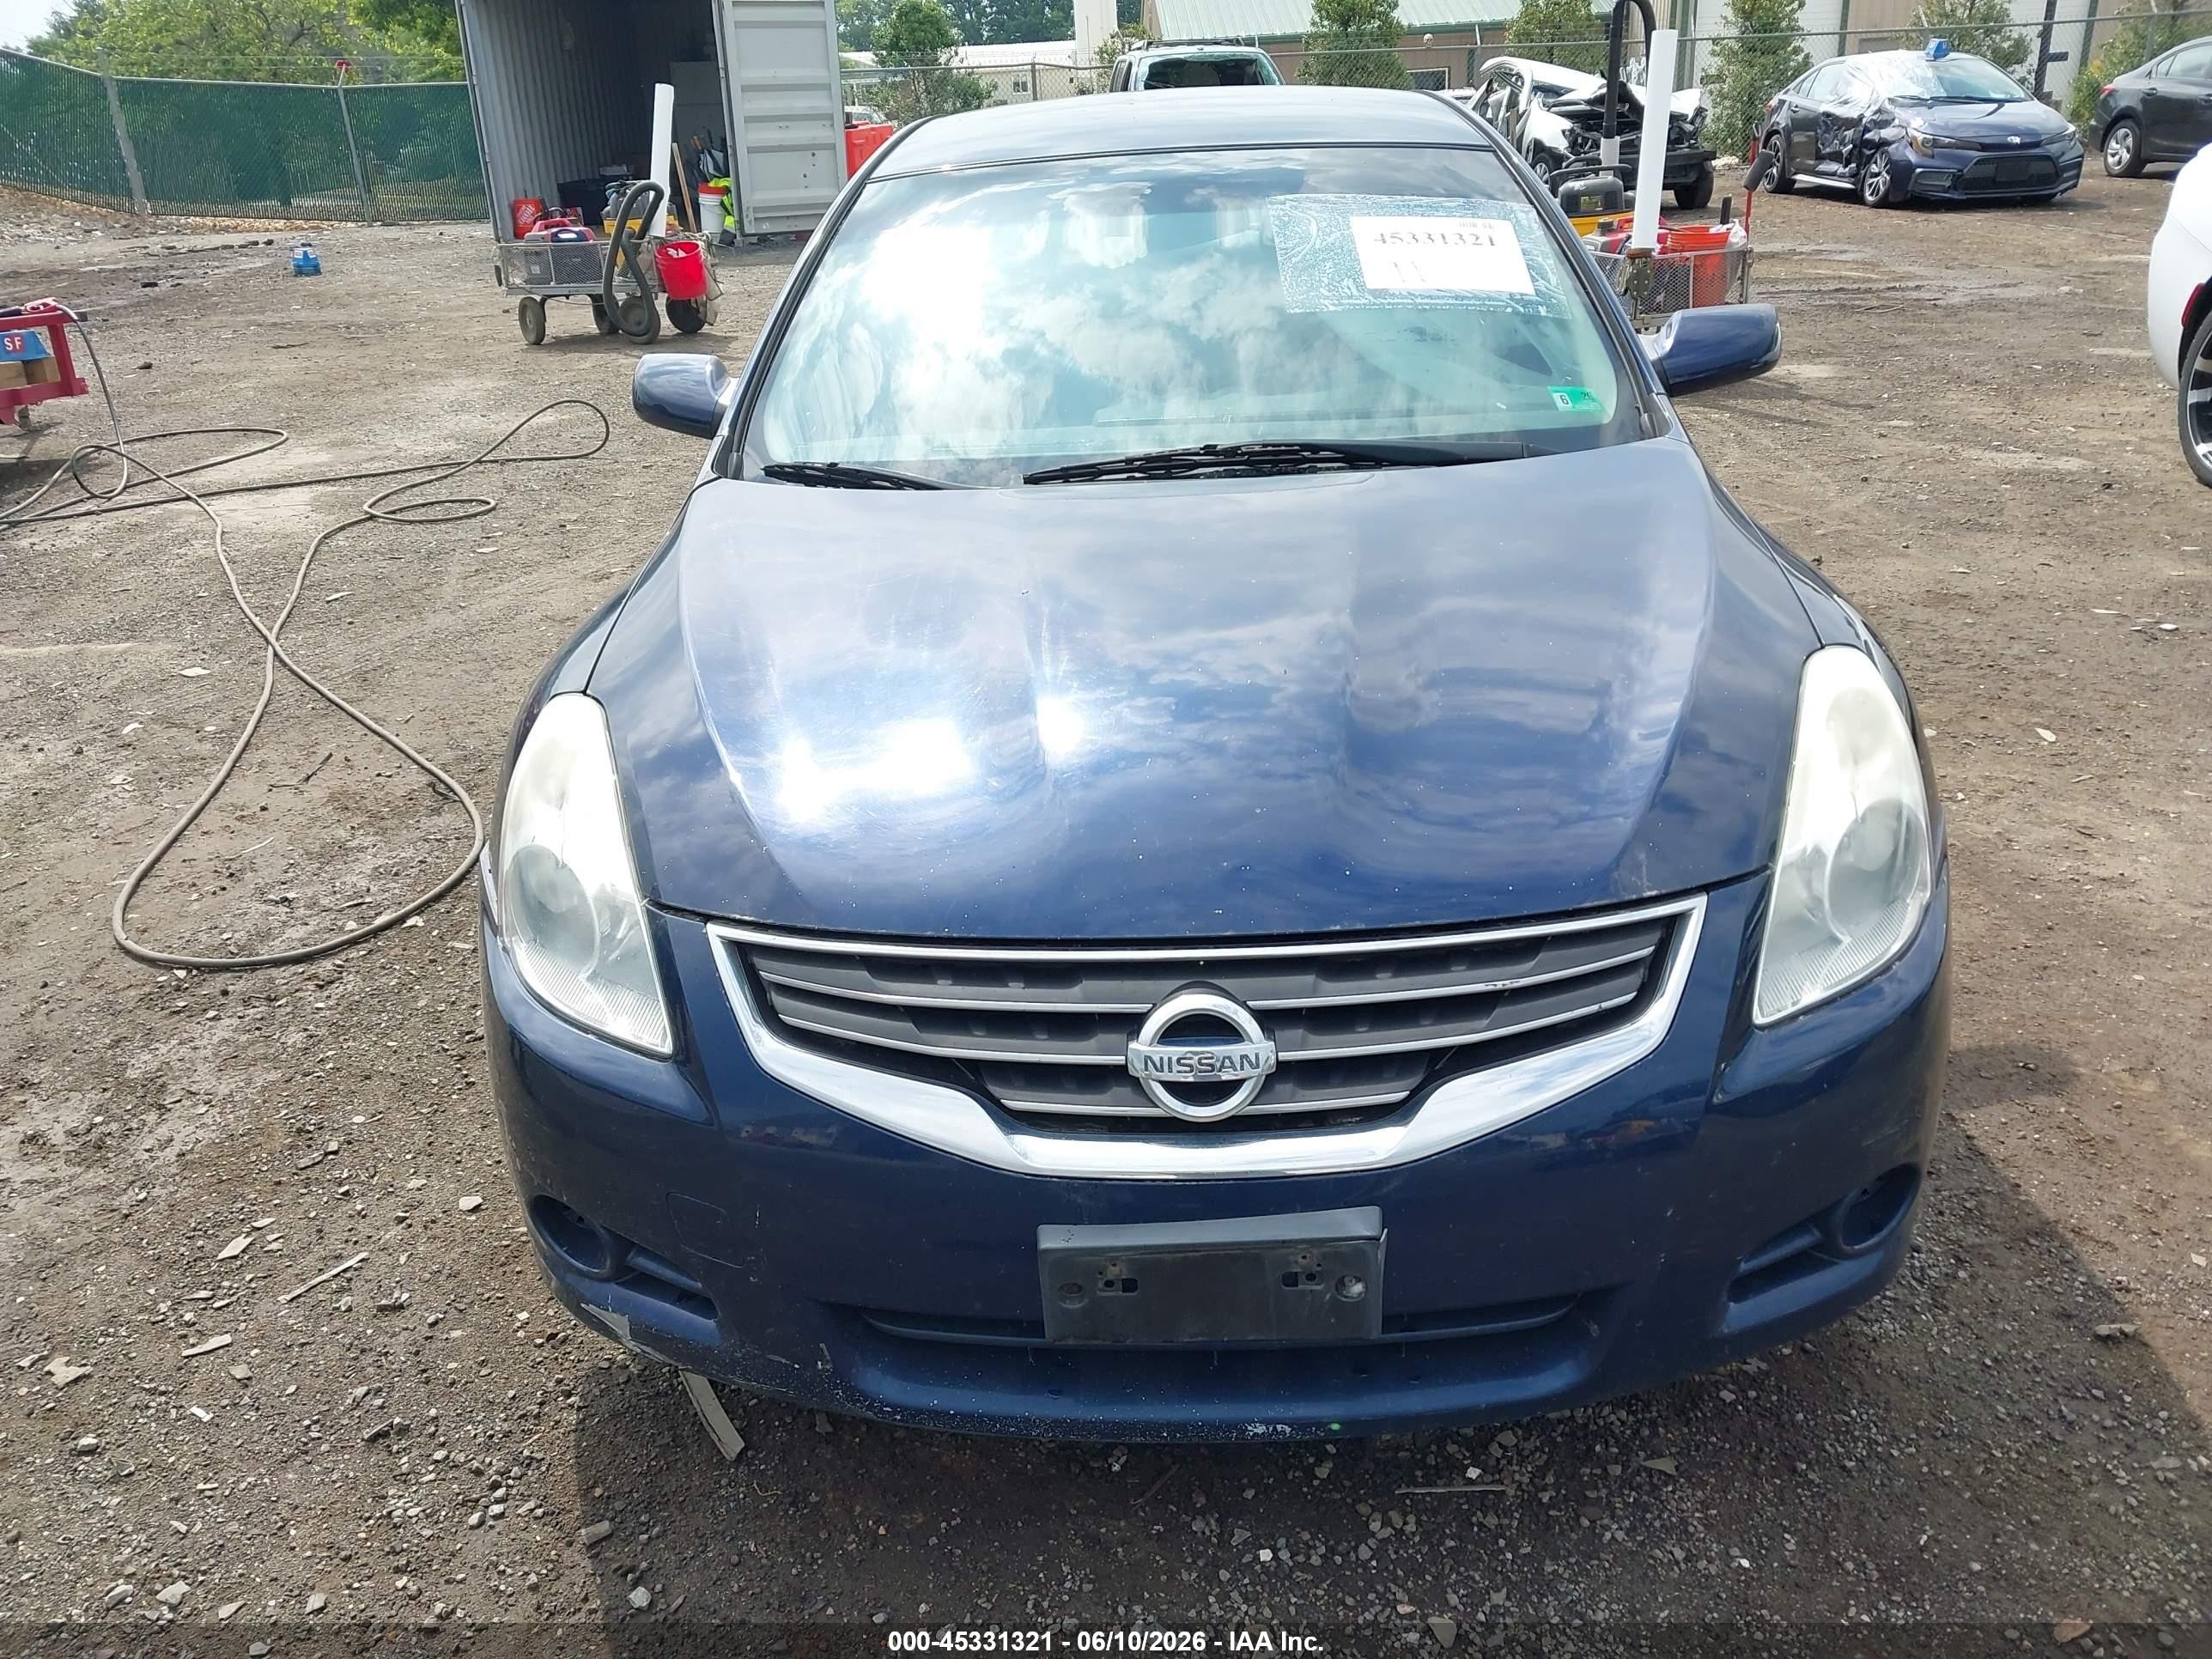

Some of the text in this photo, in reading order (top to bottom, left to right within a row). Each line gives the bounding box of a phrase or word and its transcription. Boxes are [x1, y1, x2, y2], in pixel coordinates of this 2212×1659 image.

[3, 336, 21, 350] SF
[1559, 394, 1570, 405] 6
[1143, 1051, 1261, 1074] NISSAN
